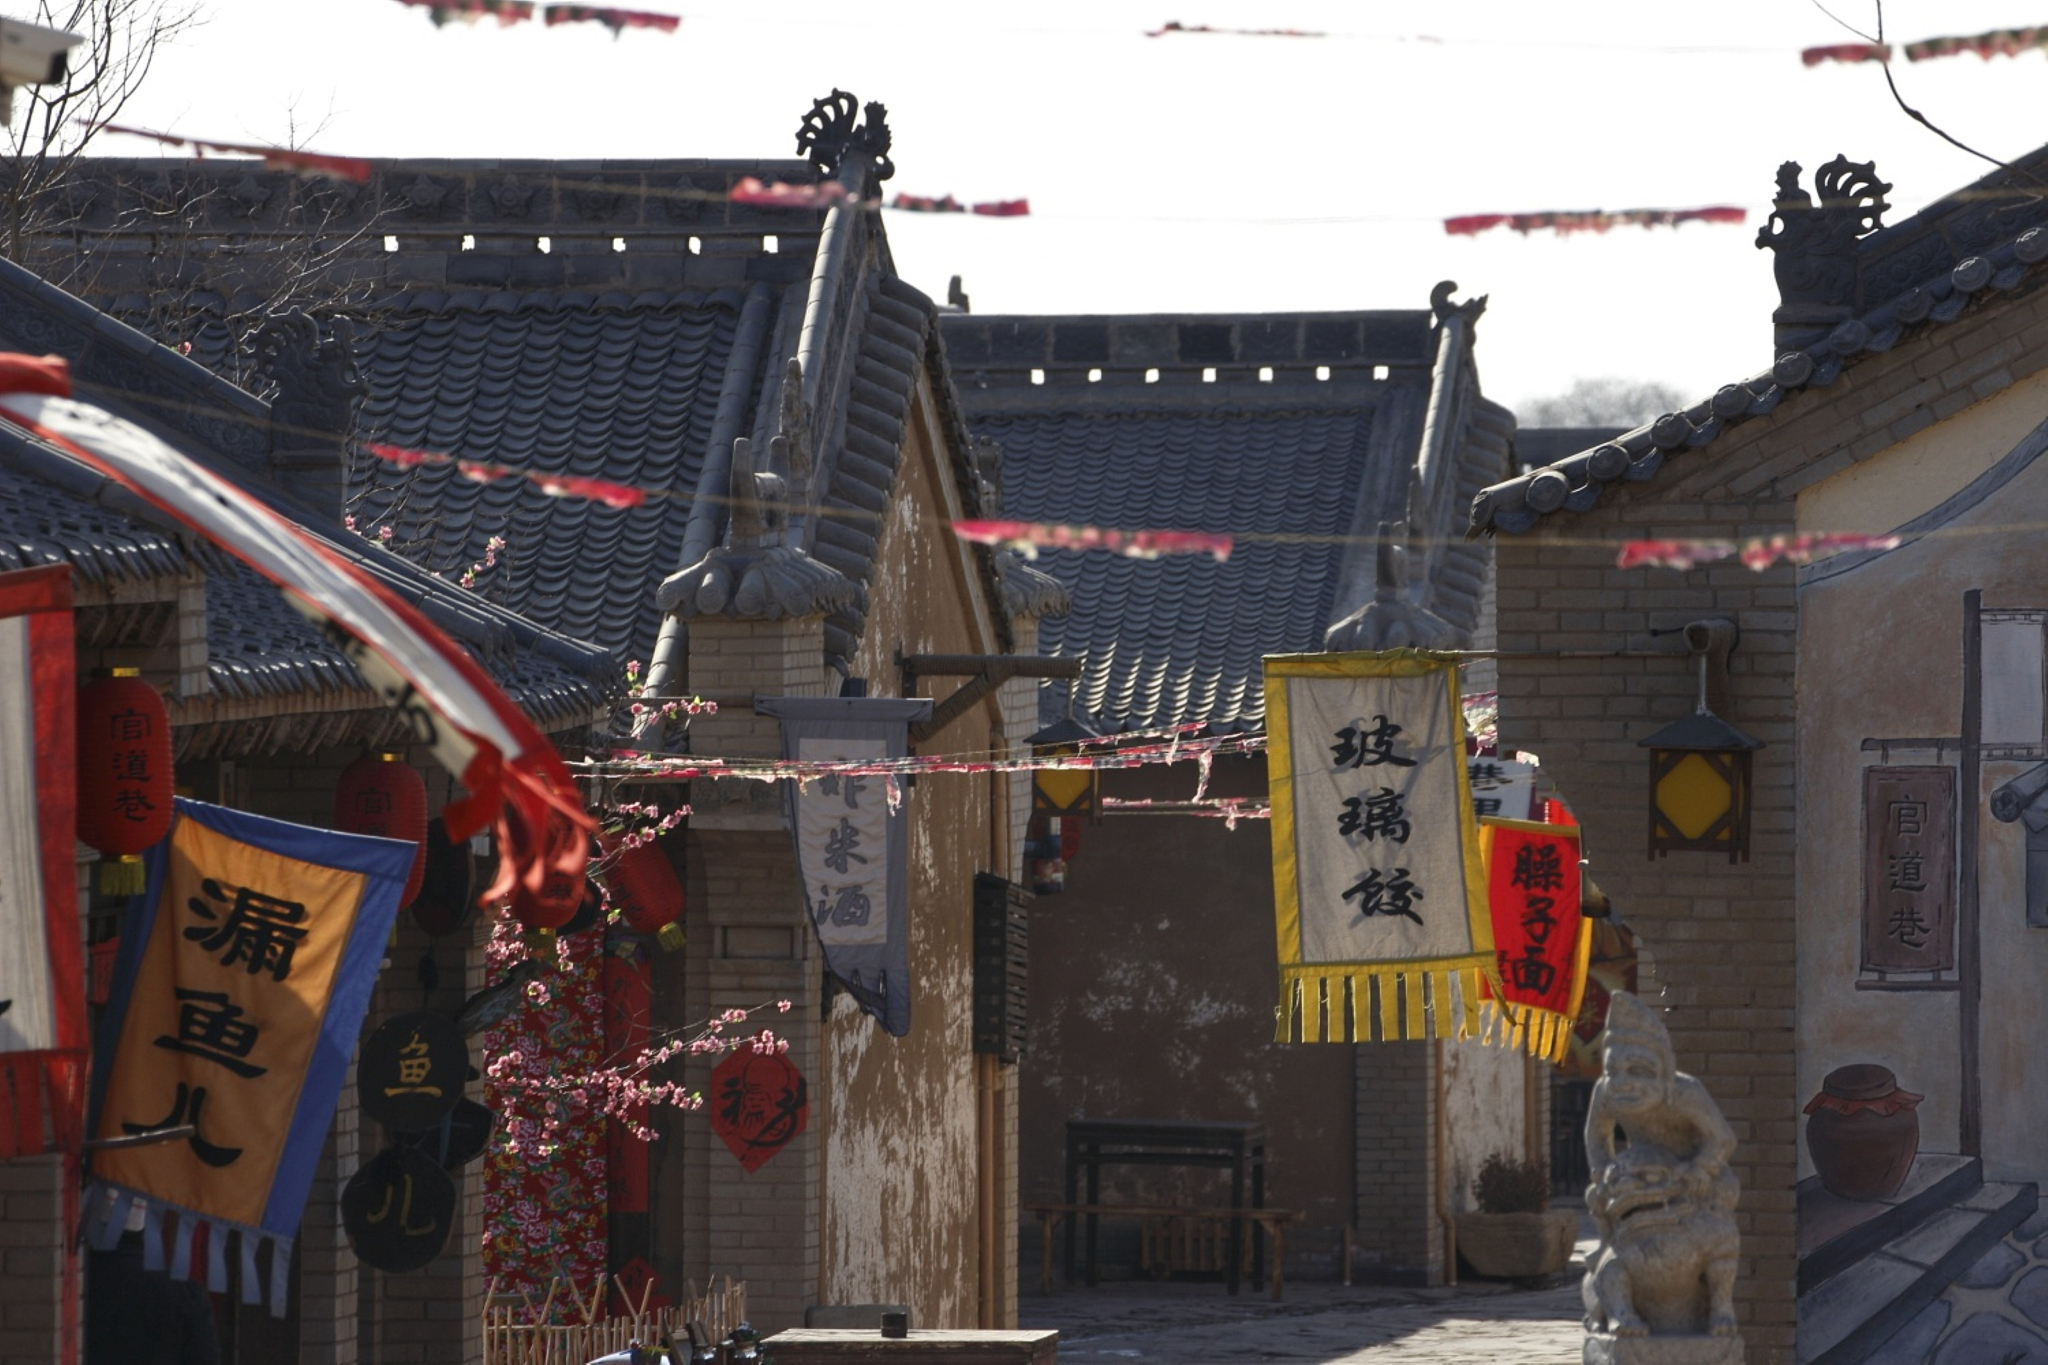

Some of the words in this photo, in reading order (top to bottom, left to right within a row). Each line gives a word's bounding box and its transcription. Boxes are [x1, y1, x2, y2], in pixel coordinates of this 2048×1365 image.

[111, 708, 155, 822] 官道巷
[1330, 714, 1424, 927] 玻璃饺
[1511, 843, 1565, 996] 臊子面
[1888, 794, 1931, 949] 官道巷
[122, 877, 309, 1168] 漏鱼儿
[382, 1032, 444, 1099] 鱼
